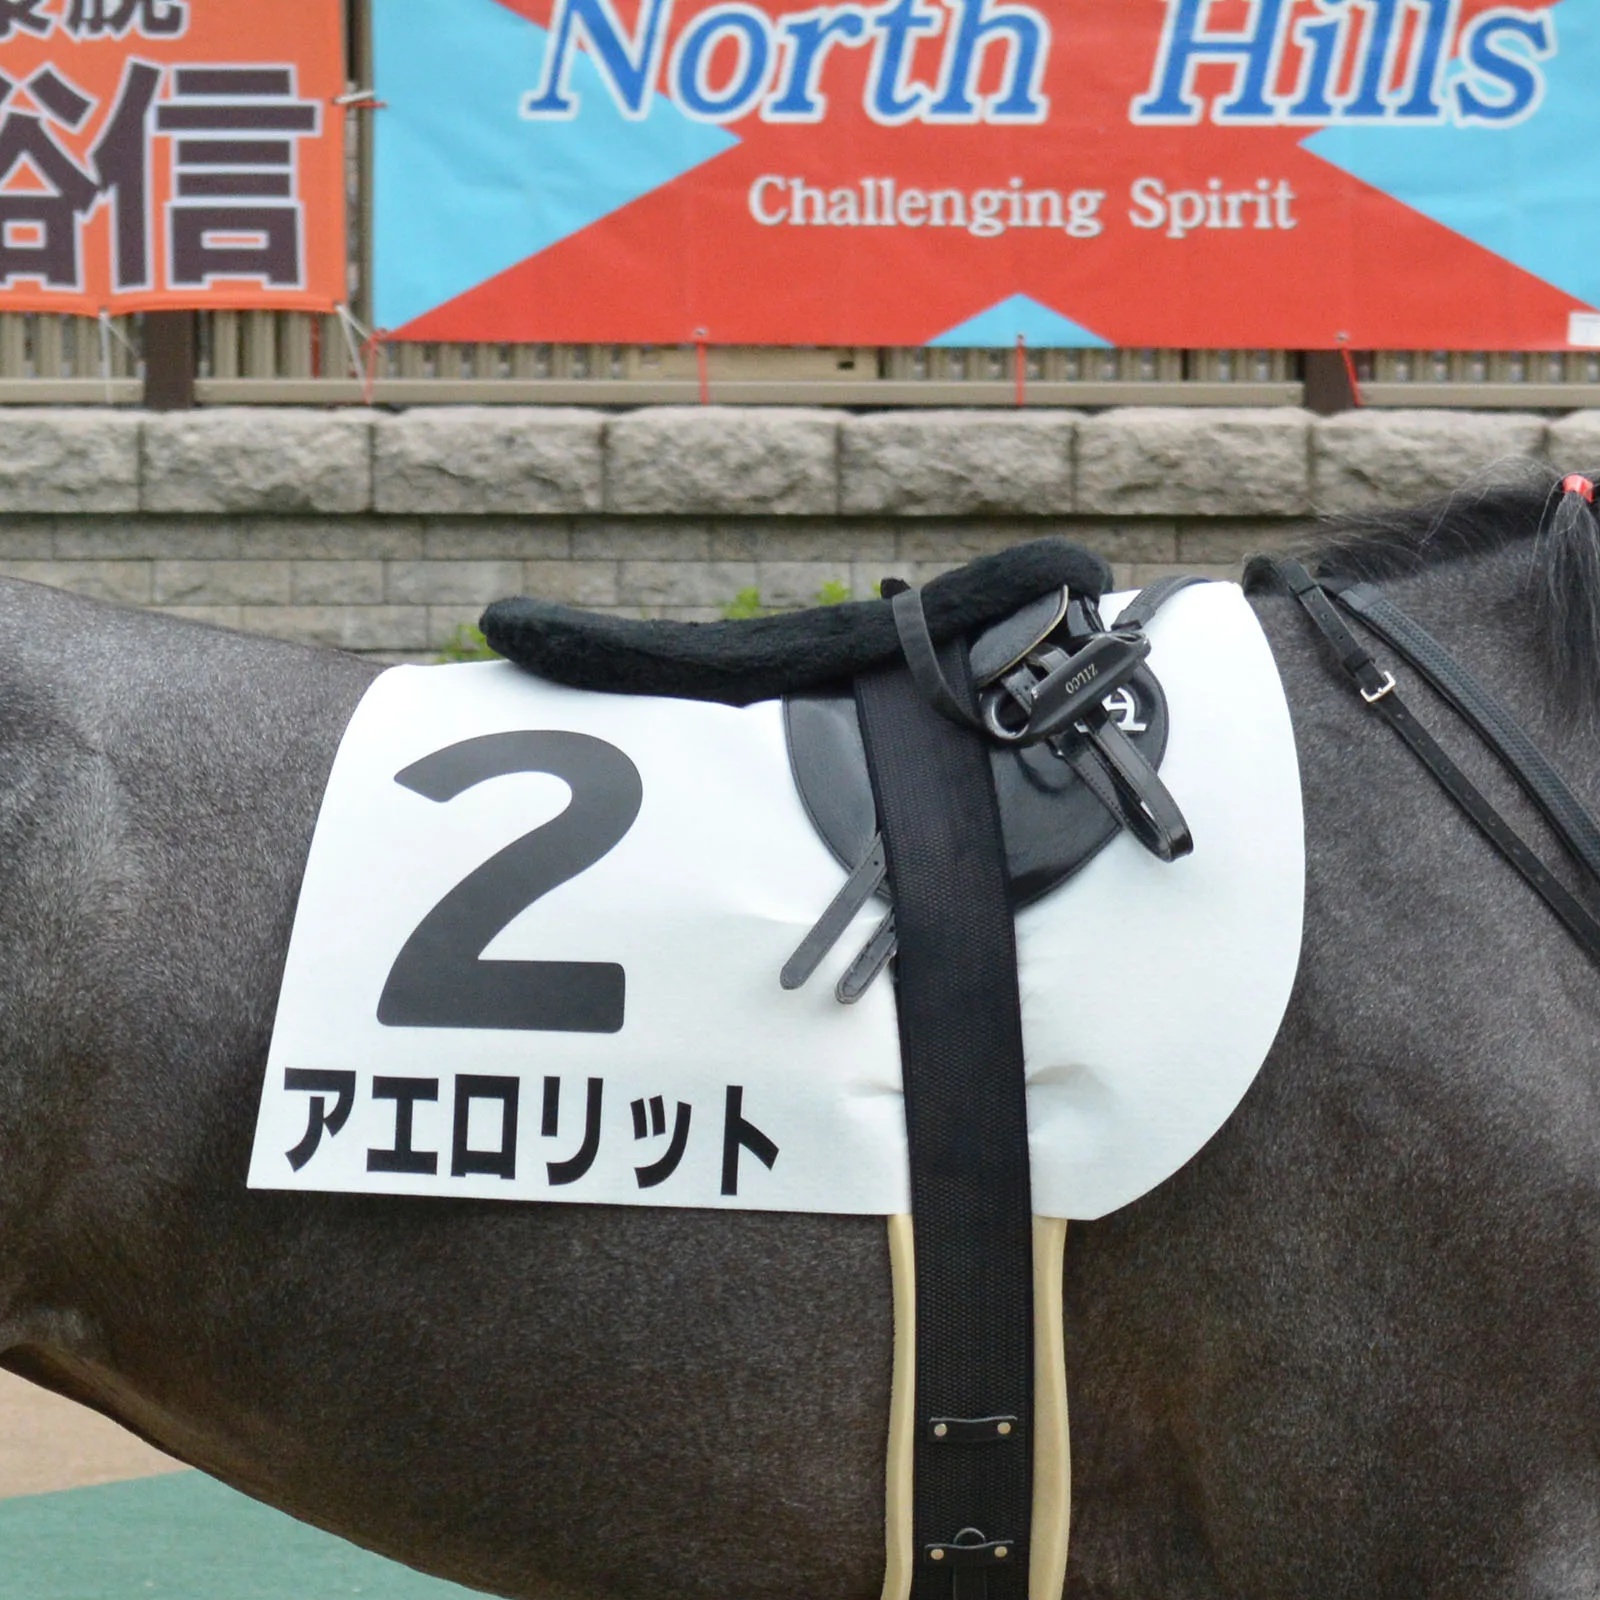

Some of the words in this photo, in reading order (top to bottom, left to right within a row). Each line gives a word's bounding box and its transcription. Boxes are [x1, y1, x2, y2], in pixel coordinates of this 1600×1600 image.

[527, 0, 1042, 118] North
[1138, 0, 1552, 121] Hills
[748, 174, 1106, 238] Challenging
[1128, 177, 1298, 239] Spirit
[376, 730, 643, 1034] 2
[283, 1066, 780, 1196] アエロリット
